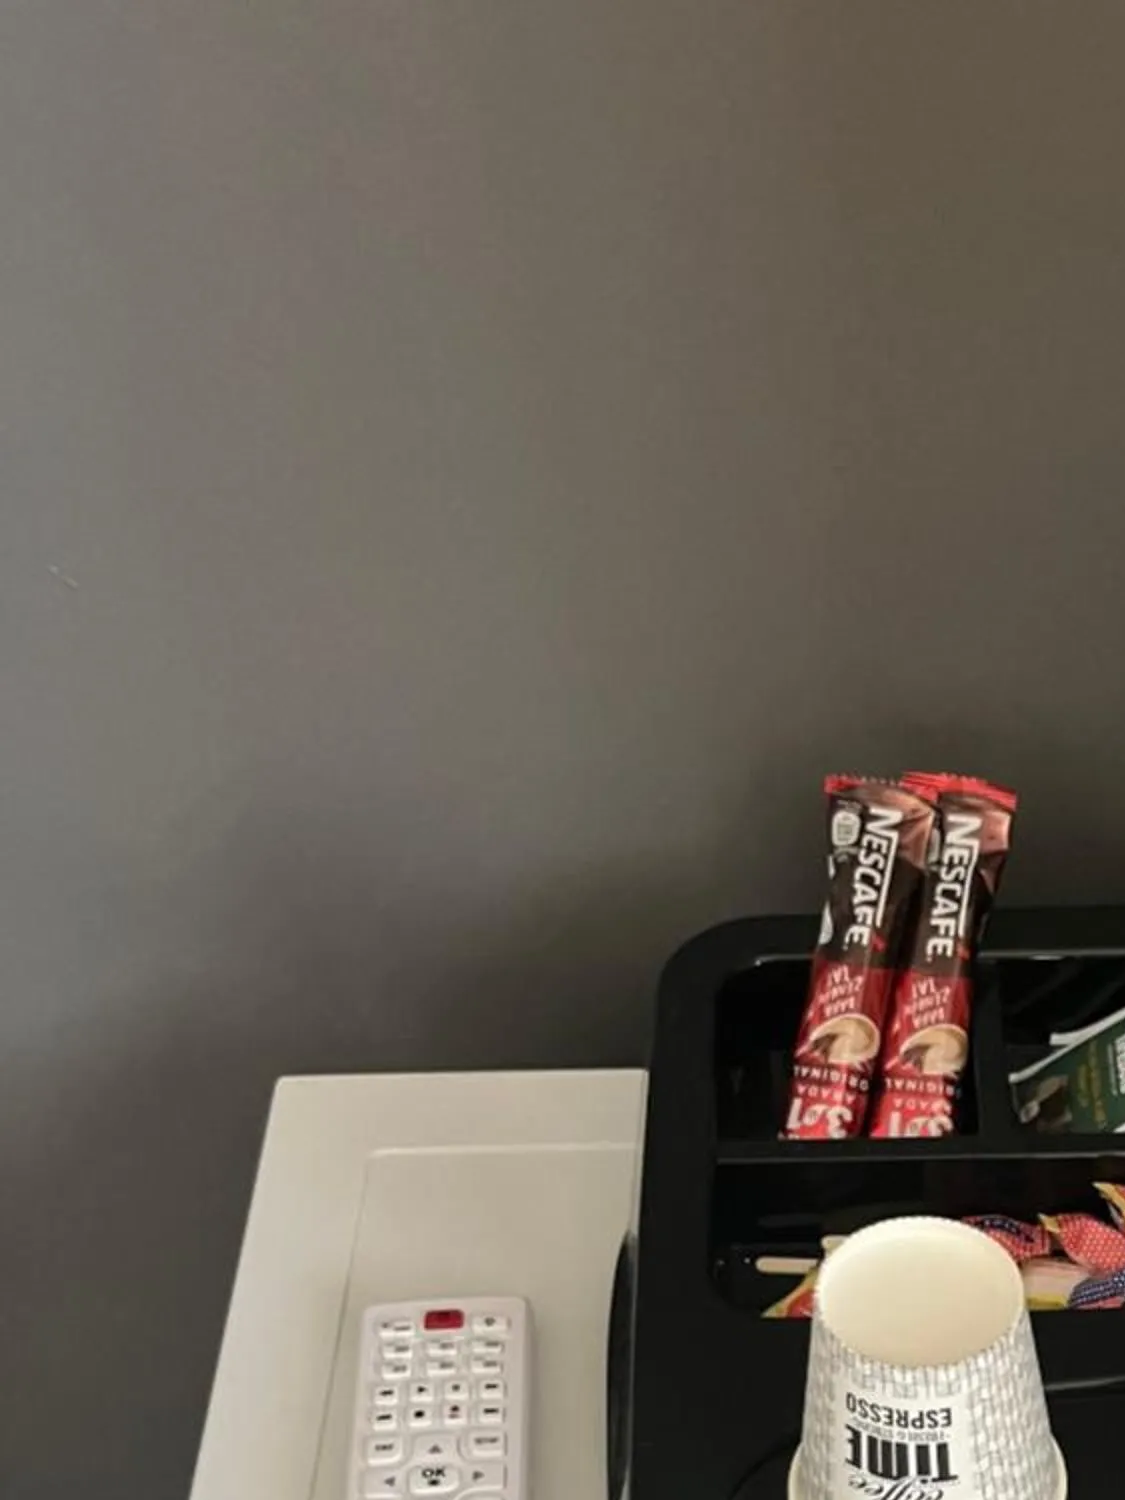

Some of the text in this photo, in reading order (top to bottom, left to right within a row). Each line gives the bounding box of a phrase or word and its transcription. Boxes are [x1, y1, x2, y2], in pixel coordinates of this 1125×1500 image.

[793, 1064, 869, 1092] ORIGINAL
[845, 1391, 952, 1430] ESPRESSO
[421, 1466, 446, 1478] OK
